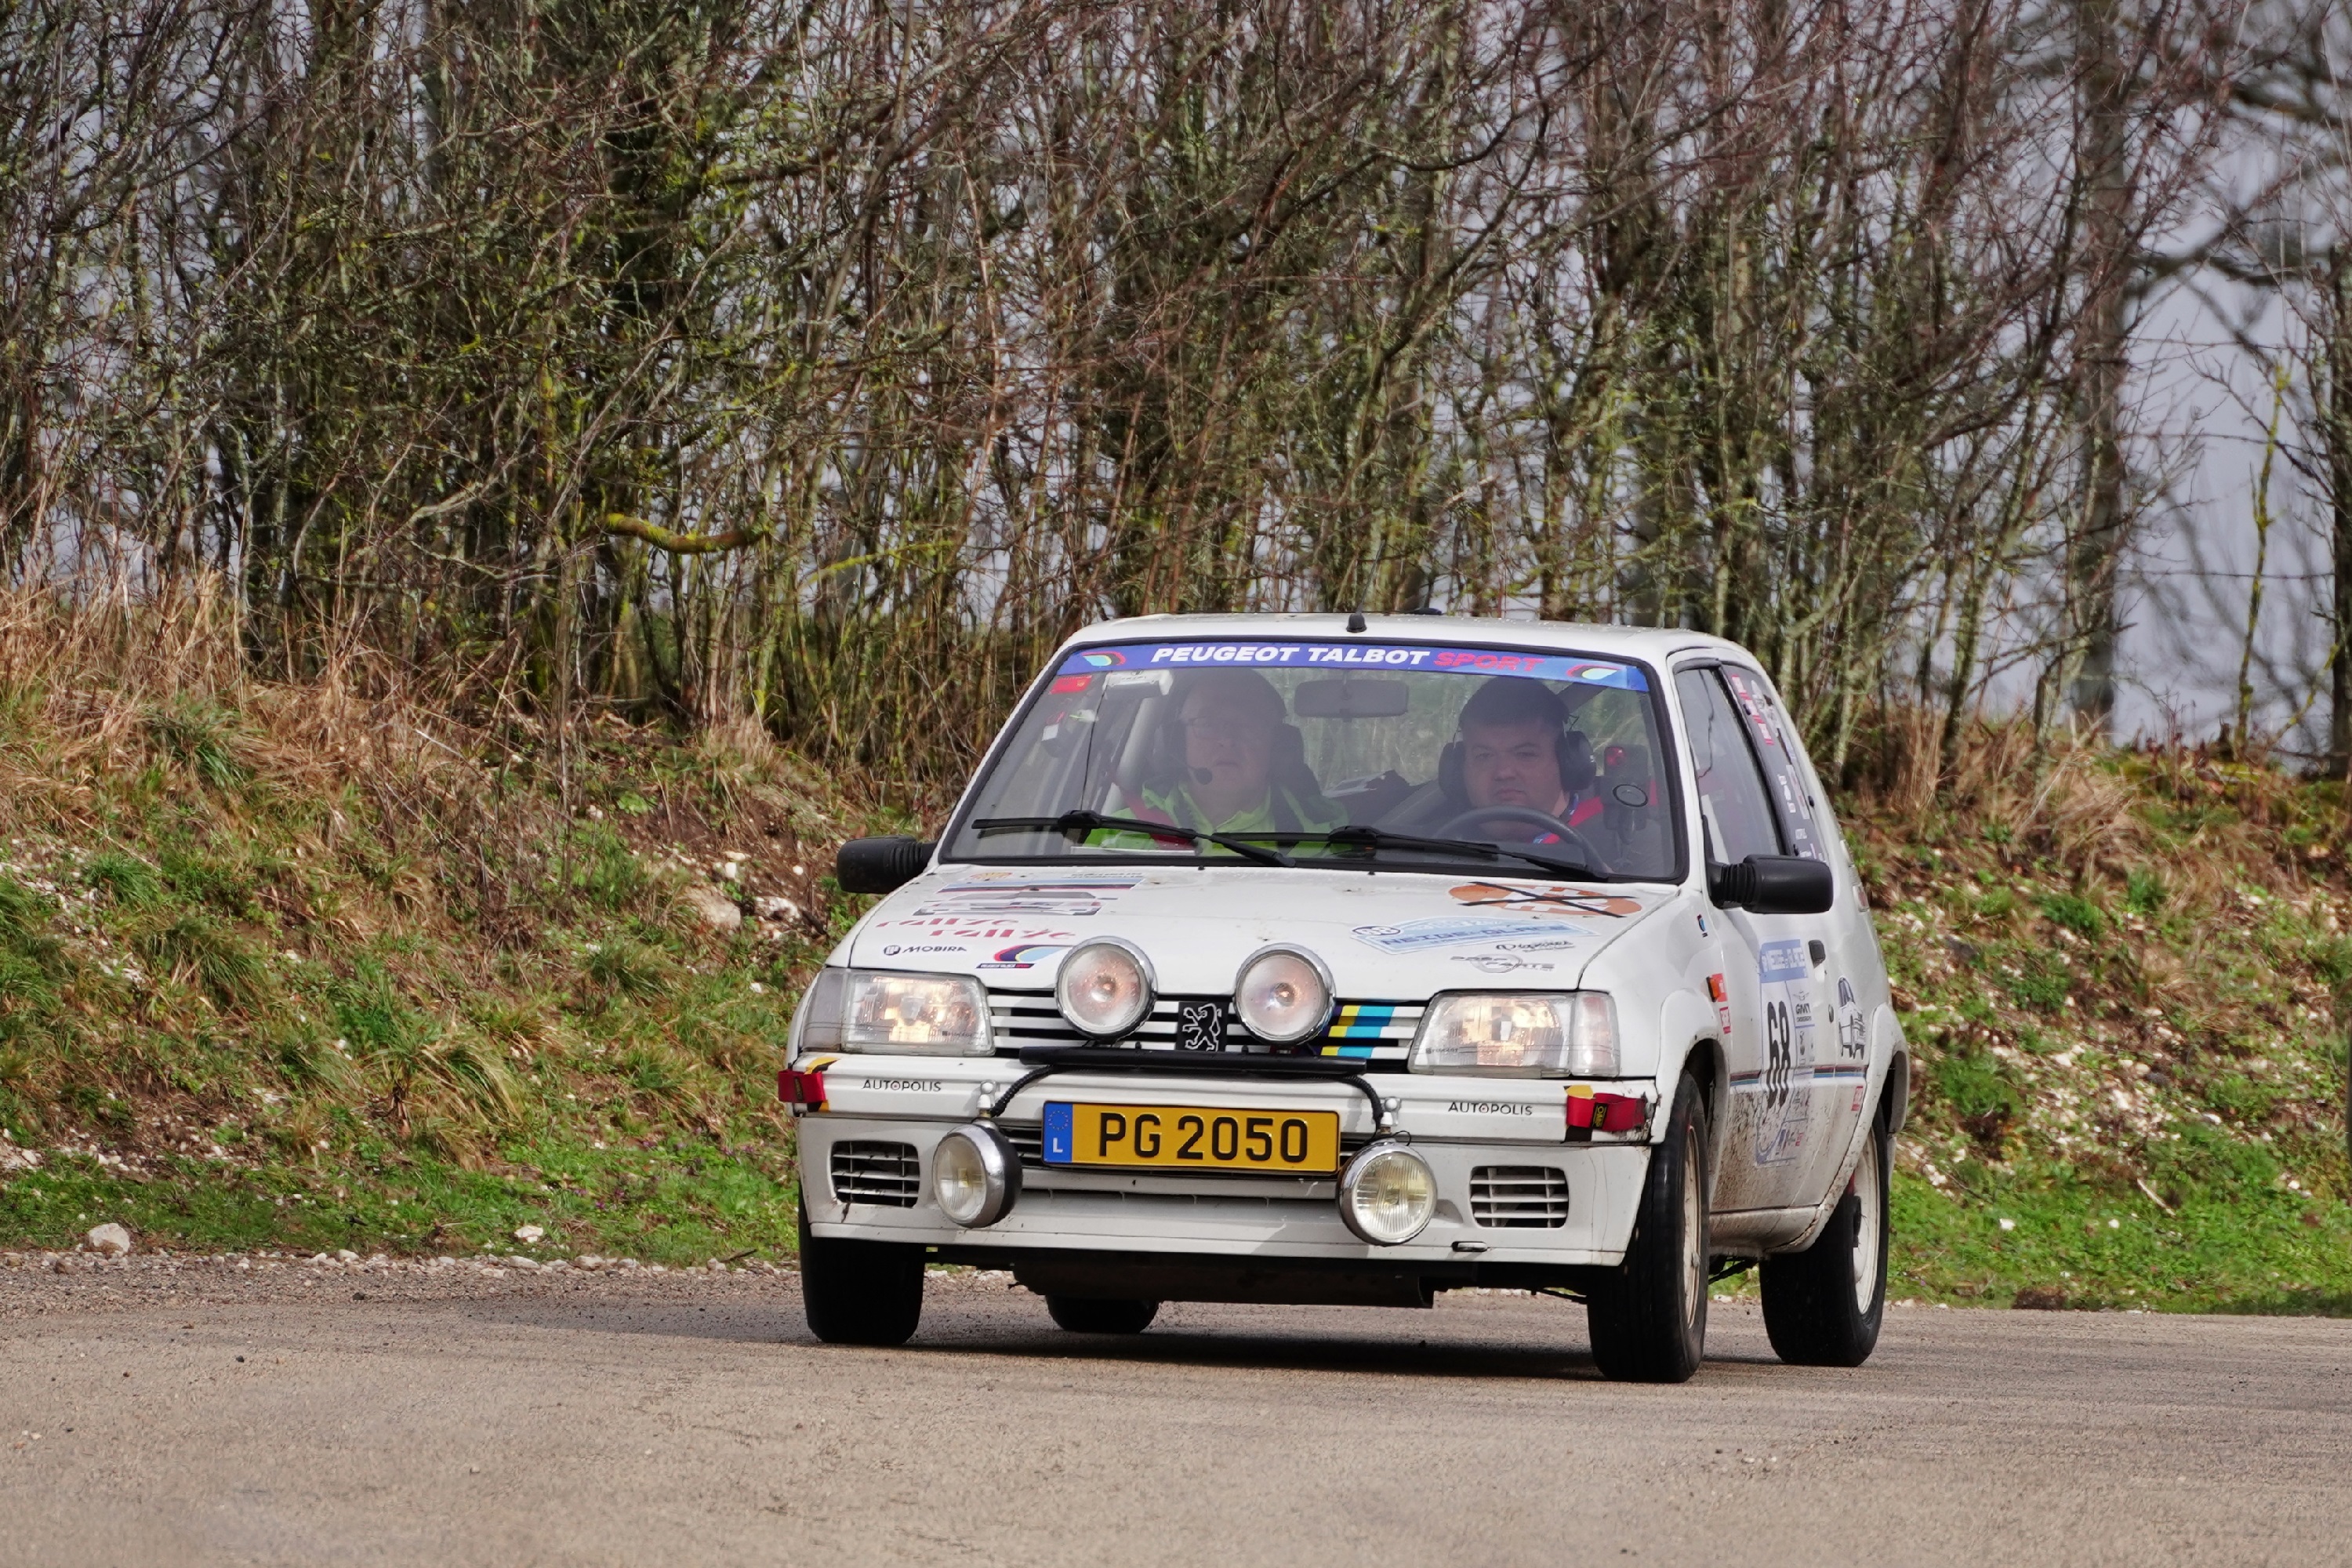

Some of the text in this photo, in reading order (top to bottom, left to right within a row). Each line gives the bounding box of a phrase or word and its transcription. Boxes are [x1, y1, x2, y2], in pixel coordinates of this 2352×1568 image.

[1150, 647, 1544, 672] PEUGEOT TALBOT SPORT
[929, 928, 1076, 940] rallye
[903, 945, 967, 955] MOBIRA
[1766, 1000, 1791, 1110] 68
[862, 1079, 942, 1092] AUTOPOLIS
[1447, 1102, 1534, 1116] AUTOPOLIS
[1099, 1112, 1308, 1163] PG 2050
[1052, 1138, 1064, 1153] L
